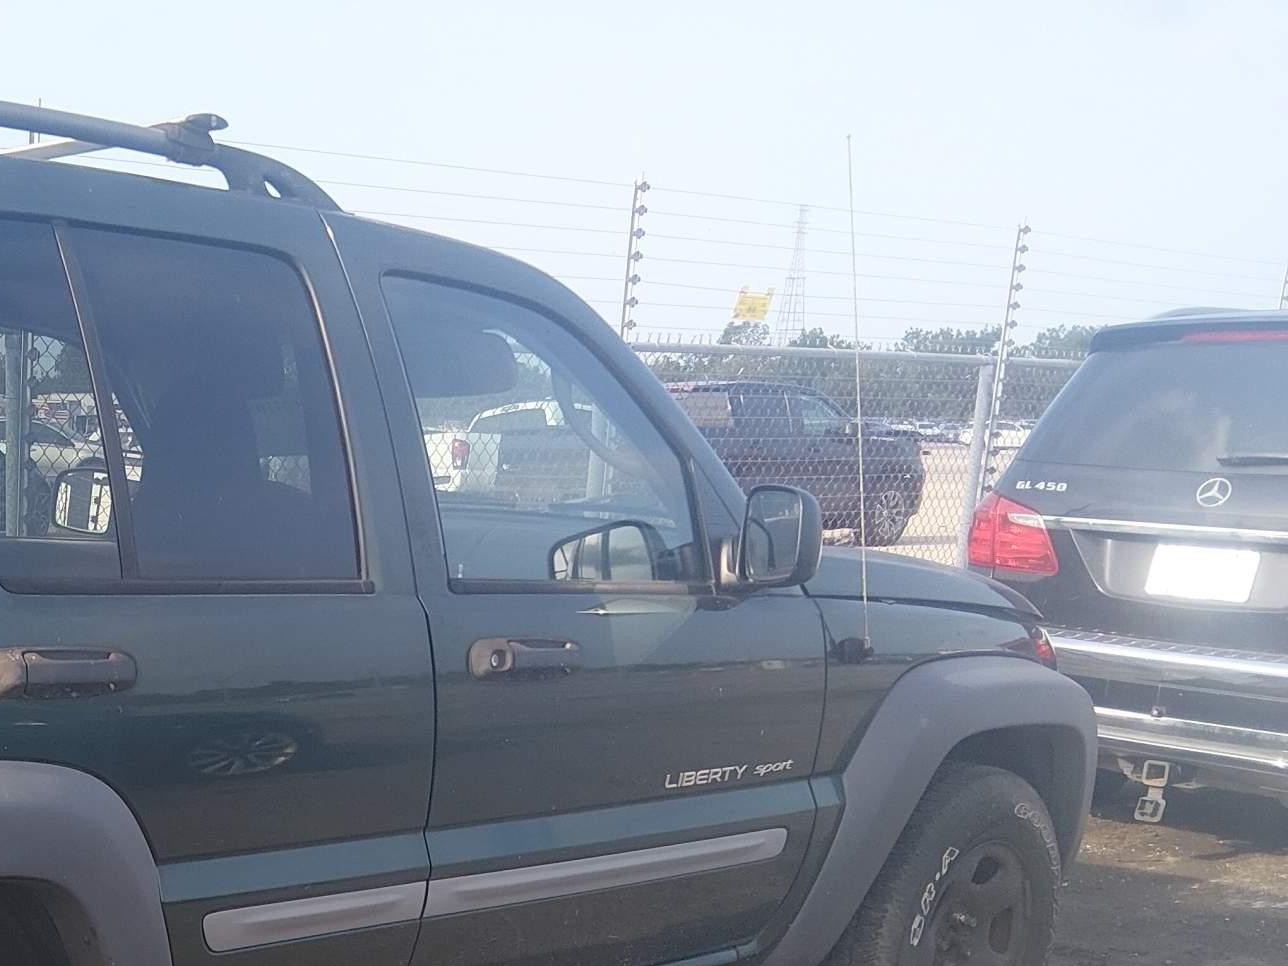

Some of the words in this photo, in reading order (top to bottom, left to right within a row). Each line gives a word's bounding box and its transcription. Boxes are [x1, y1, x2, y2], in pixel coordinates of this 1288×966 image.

[1015, 480, 1033, 490] GL
[1033, 481, 1068, 492] 450
[664, 764, 749, 789] LIBERTY
[752, 759, 794, 777] sport
